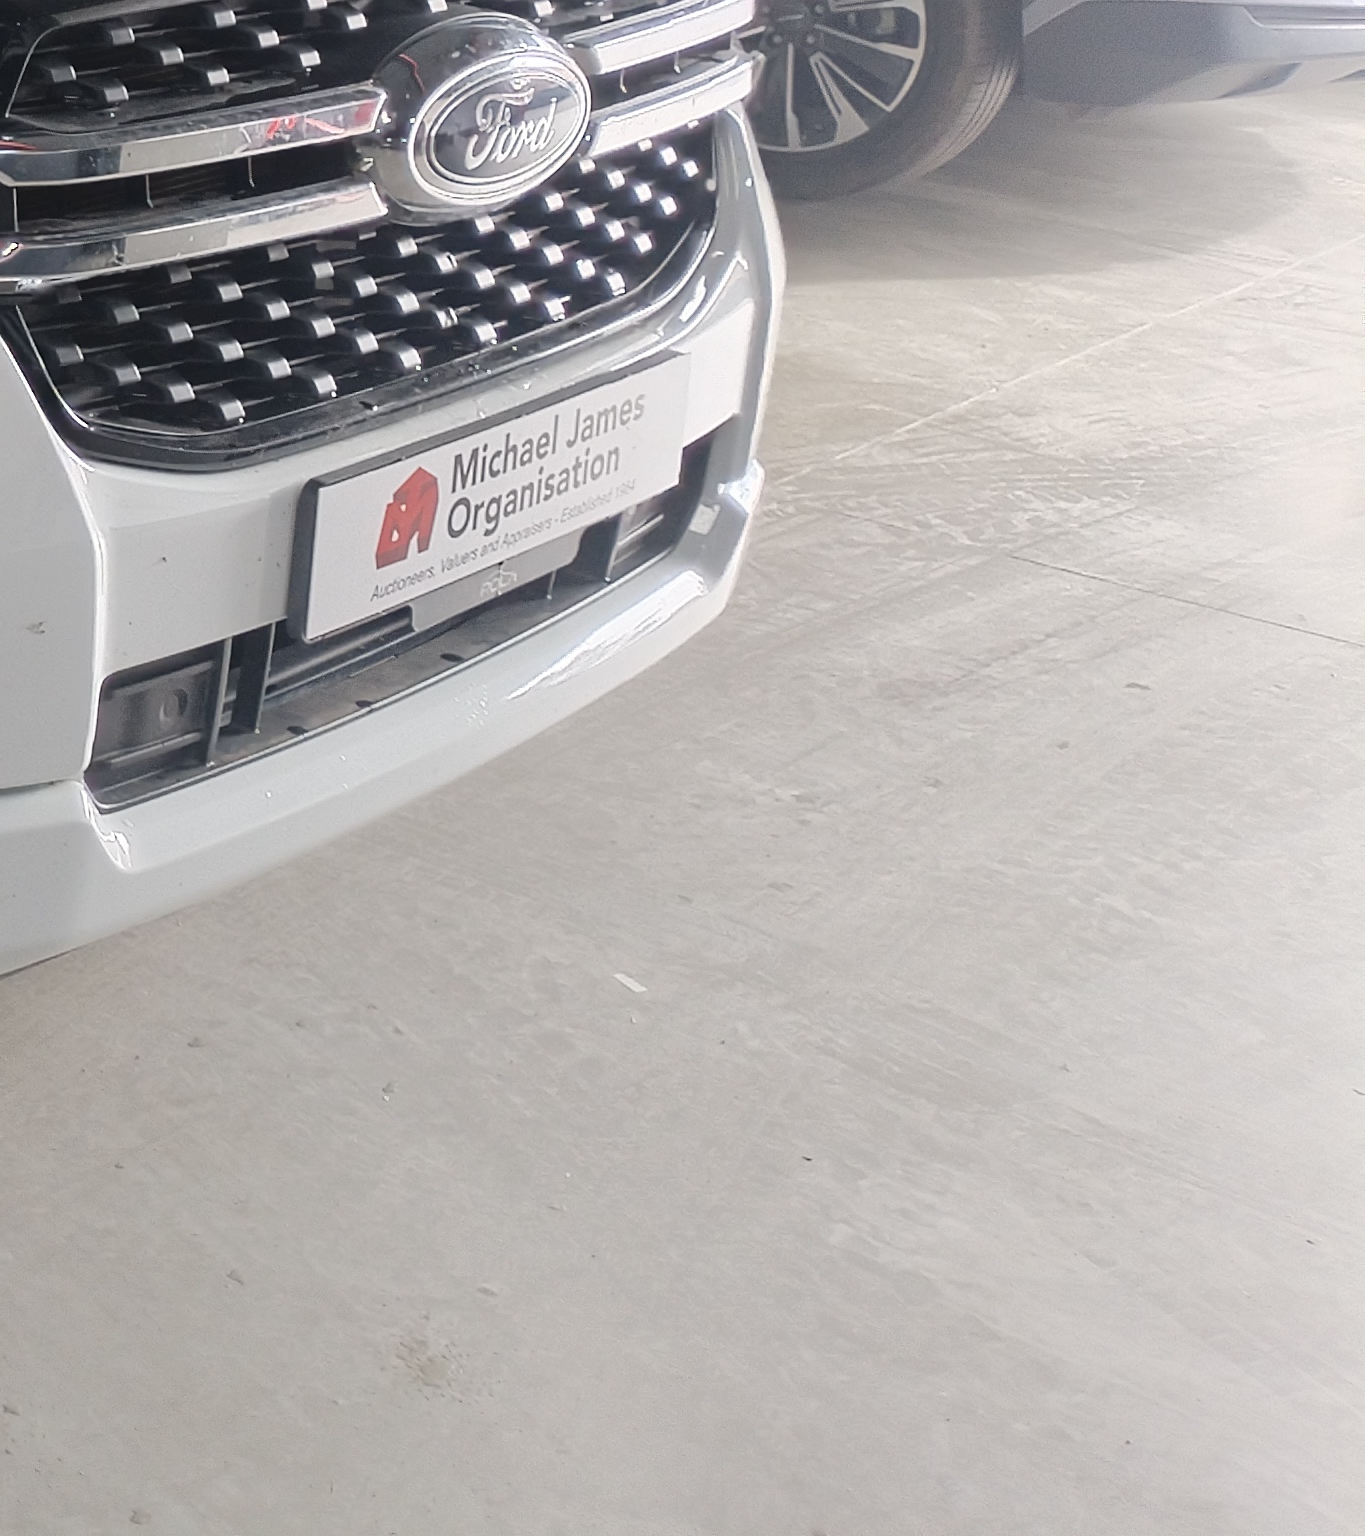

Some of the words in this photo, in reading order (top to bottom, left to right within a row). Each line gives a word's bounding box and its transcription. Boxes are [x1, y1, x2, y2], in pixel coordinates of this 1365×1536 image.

[465, 88, 557, 170] Ford
[451, 415, 559, 494] Michael
[566, 392, 646, 449] James
[447, 444, 621, 539] Organisation
[480, 535, 499, 558] and
